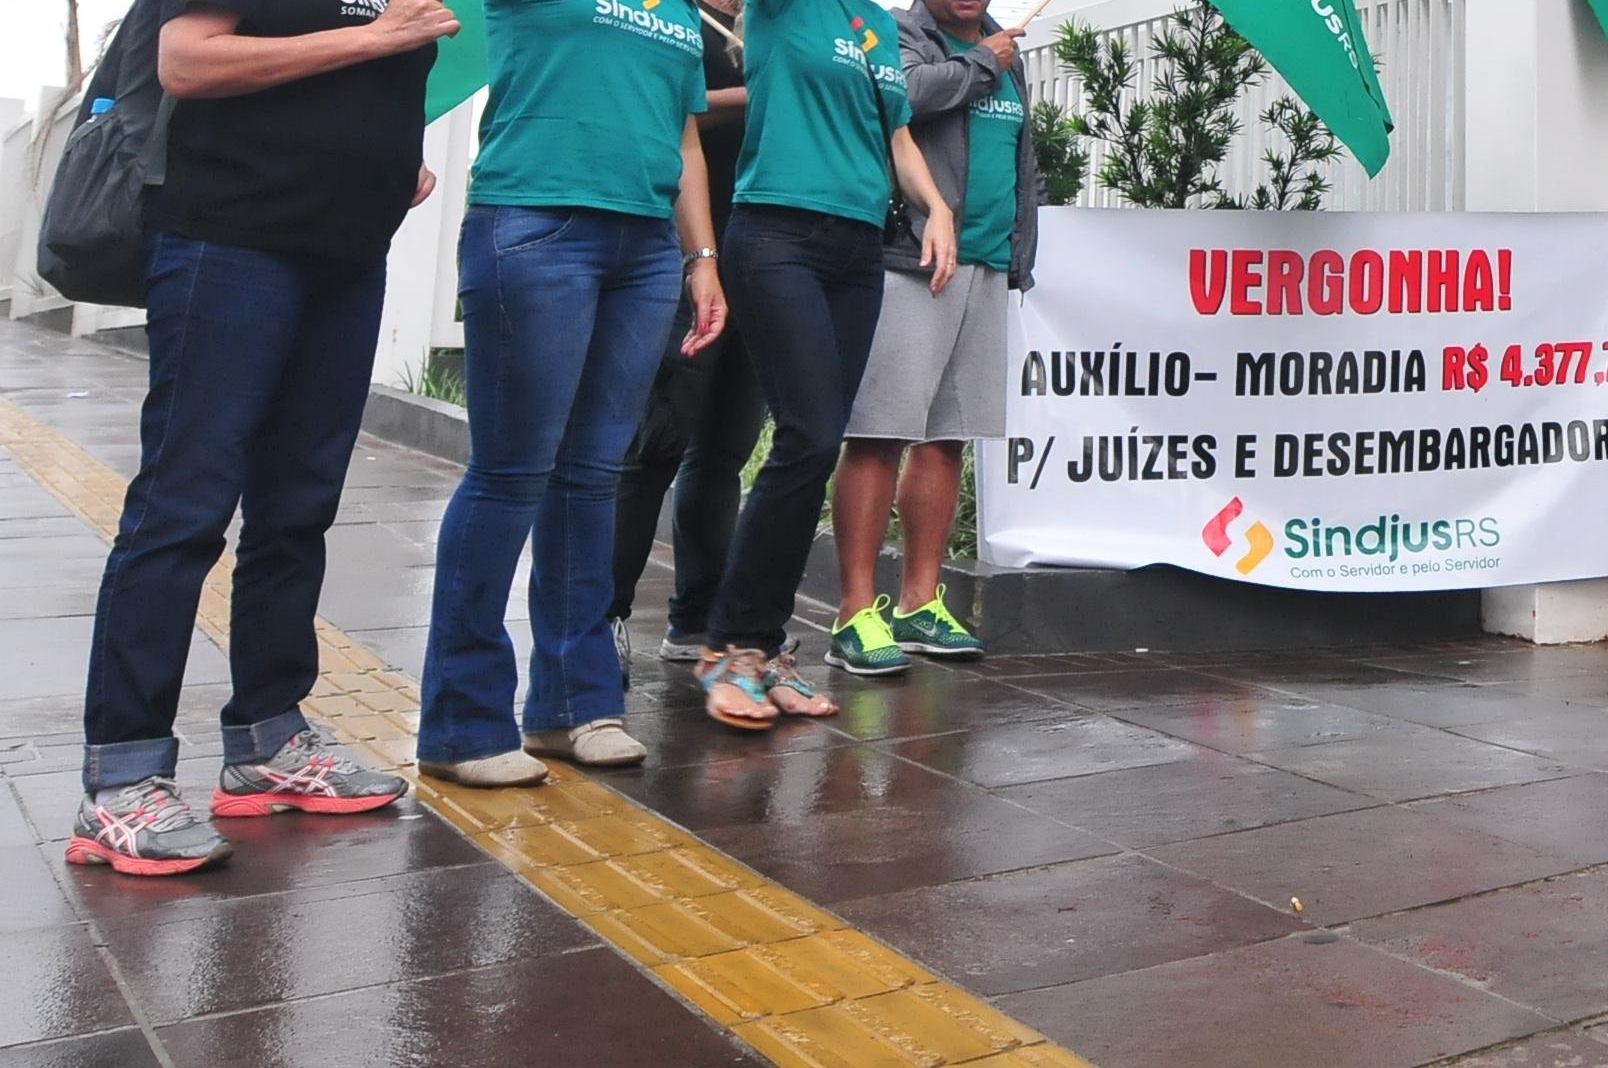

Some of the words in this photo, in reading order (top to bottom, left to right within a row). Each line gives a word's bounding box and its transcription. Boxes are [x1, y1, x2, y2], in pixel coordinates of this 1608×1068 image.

[593, 16, 612, 25] COM
[1187, 248, 1512, 315] VERGONHA!
[1235, 349, 1427, 396] MORADIA
[1442, 343, 1488, 393] R$
[1008, 434, 1055, 489] P/
[1067, 425, 1217, 482] JUÍZES
[1234, 435, 1256, 479] E
[1283, 514, 1500, 562] SindjusRS
[1290, 566, 1324, 579] Com
[1327, 569, 1336, 578] o
[1339, 563, 1396, 577] Servidor
[1399, 565, 1408, 574] e
[1412, 561, 1440, 575] pelo
[1444, 556, 1500, 571] Servidor
